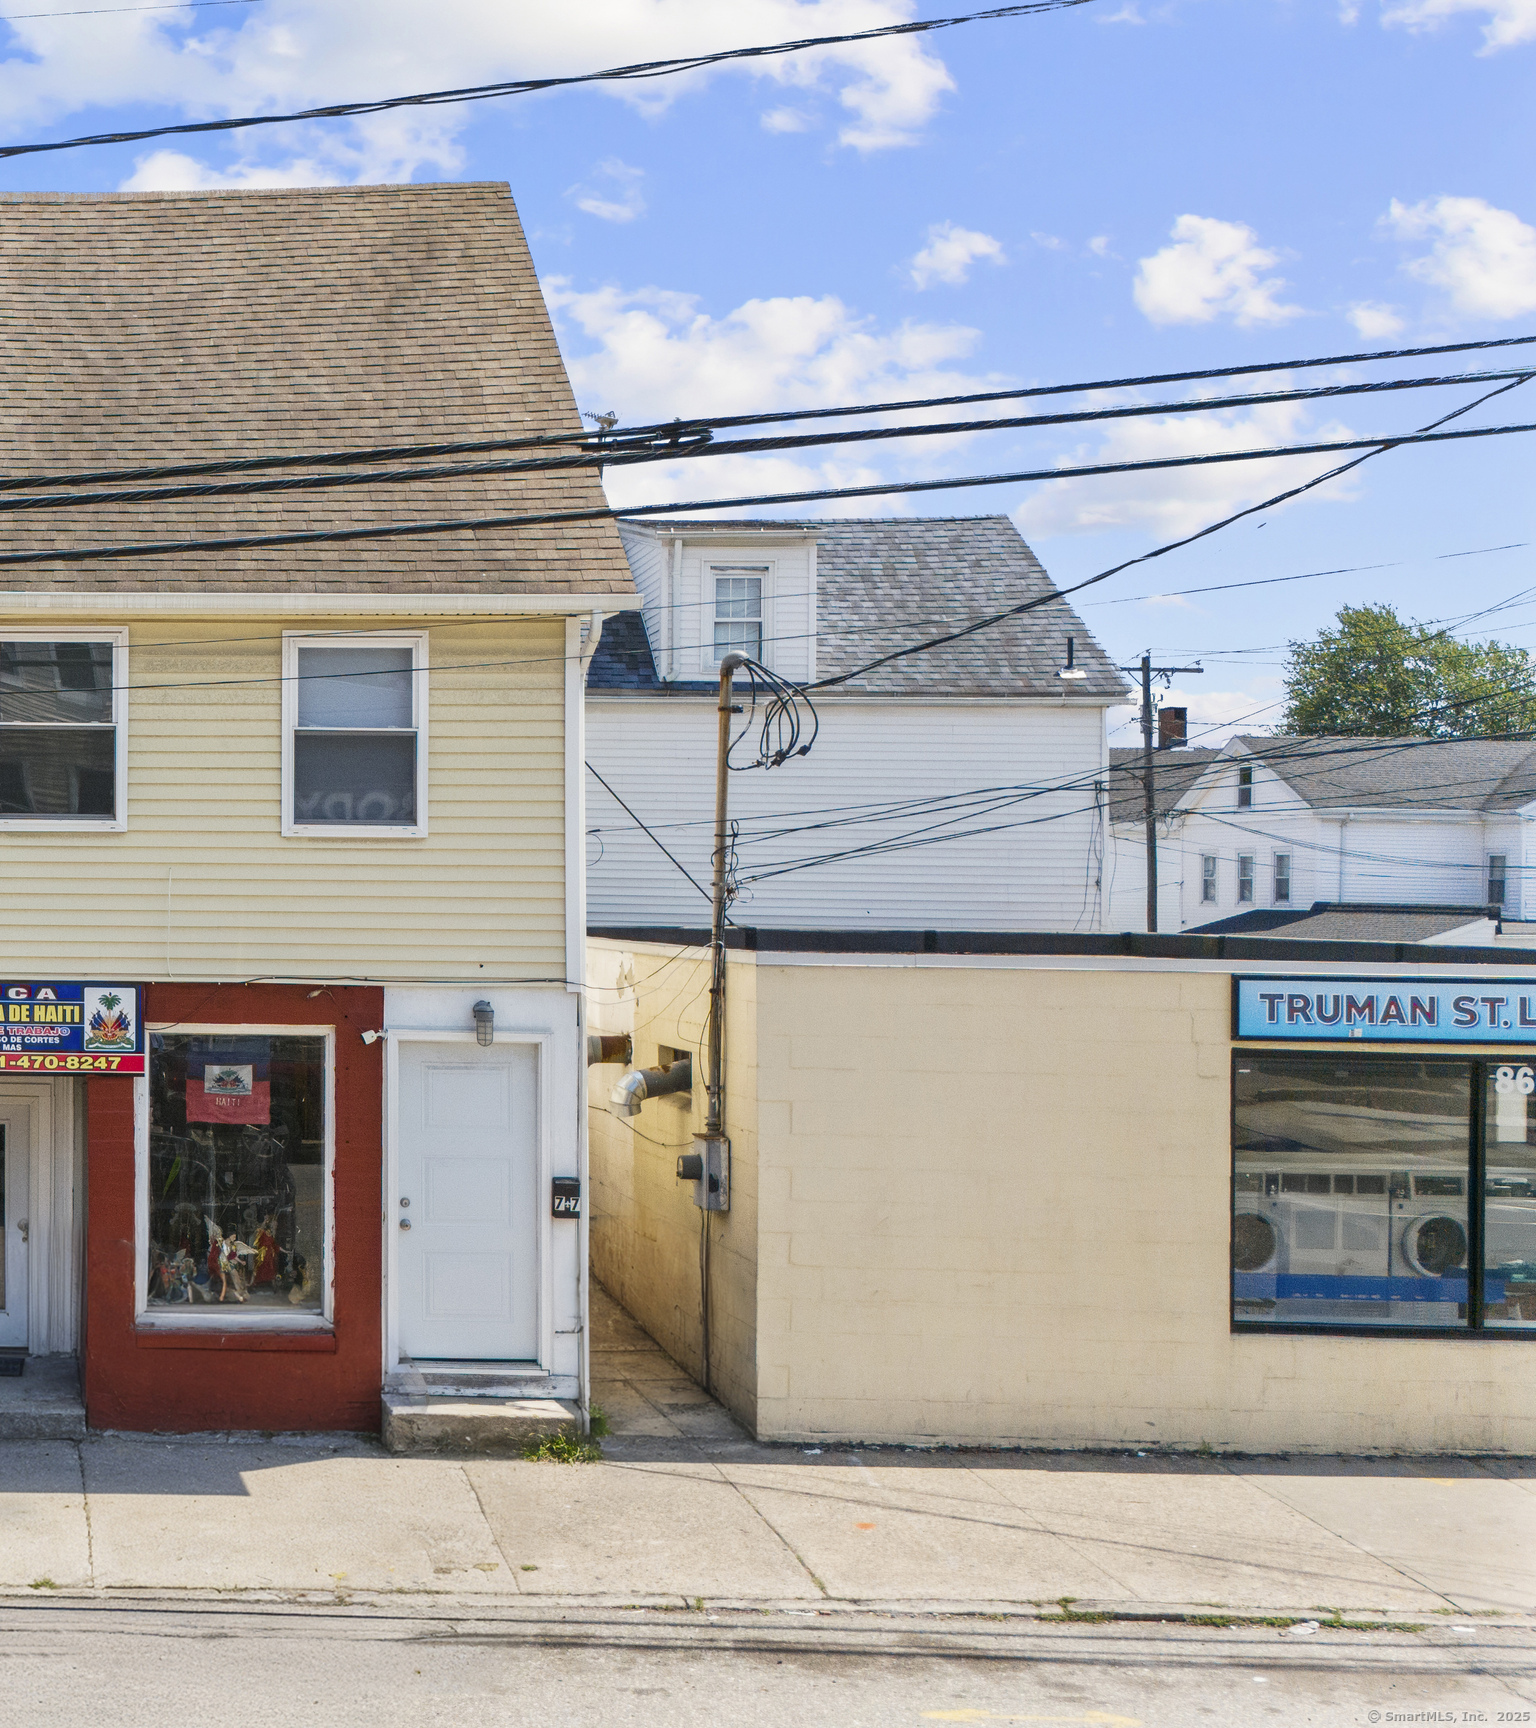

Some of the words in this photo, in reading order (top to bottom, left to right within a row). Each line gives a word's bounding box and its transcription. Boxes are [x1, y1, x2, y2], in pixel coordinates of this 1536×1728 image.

[9, 1004, 30, 1022] DE
[34, 1004, 80, 1023] HAITI
[1259, 993, 1437, 1027] TRUMAN
[1451, 995, 1511, 1028] ST.
[8, 1026, 70, 1037] TRABAJO
[24, 1036, 60, 1044] CORTES
[1495, 1066, 1535, 1095] 86
[216, 1097, 240, 1107] HAITI
